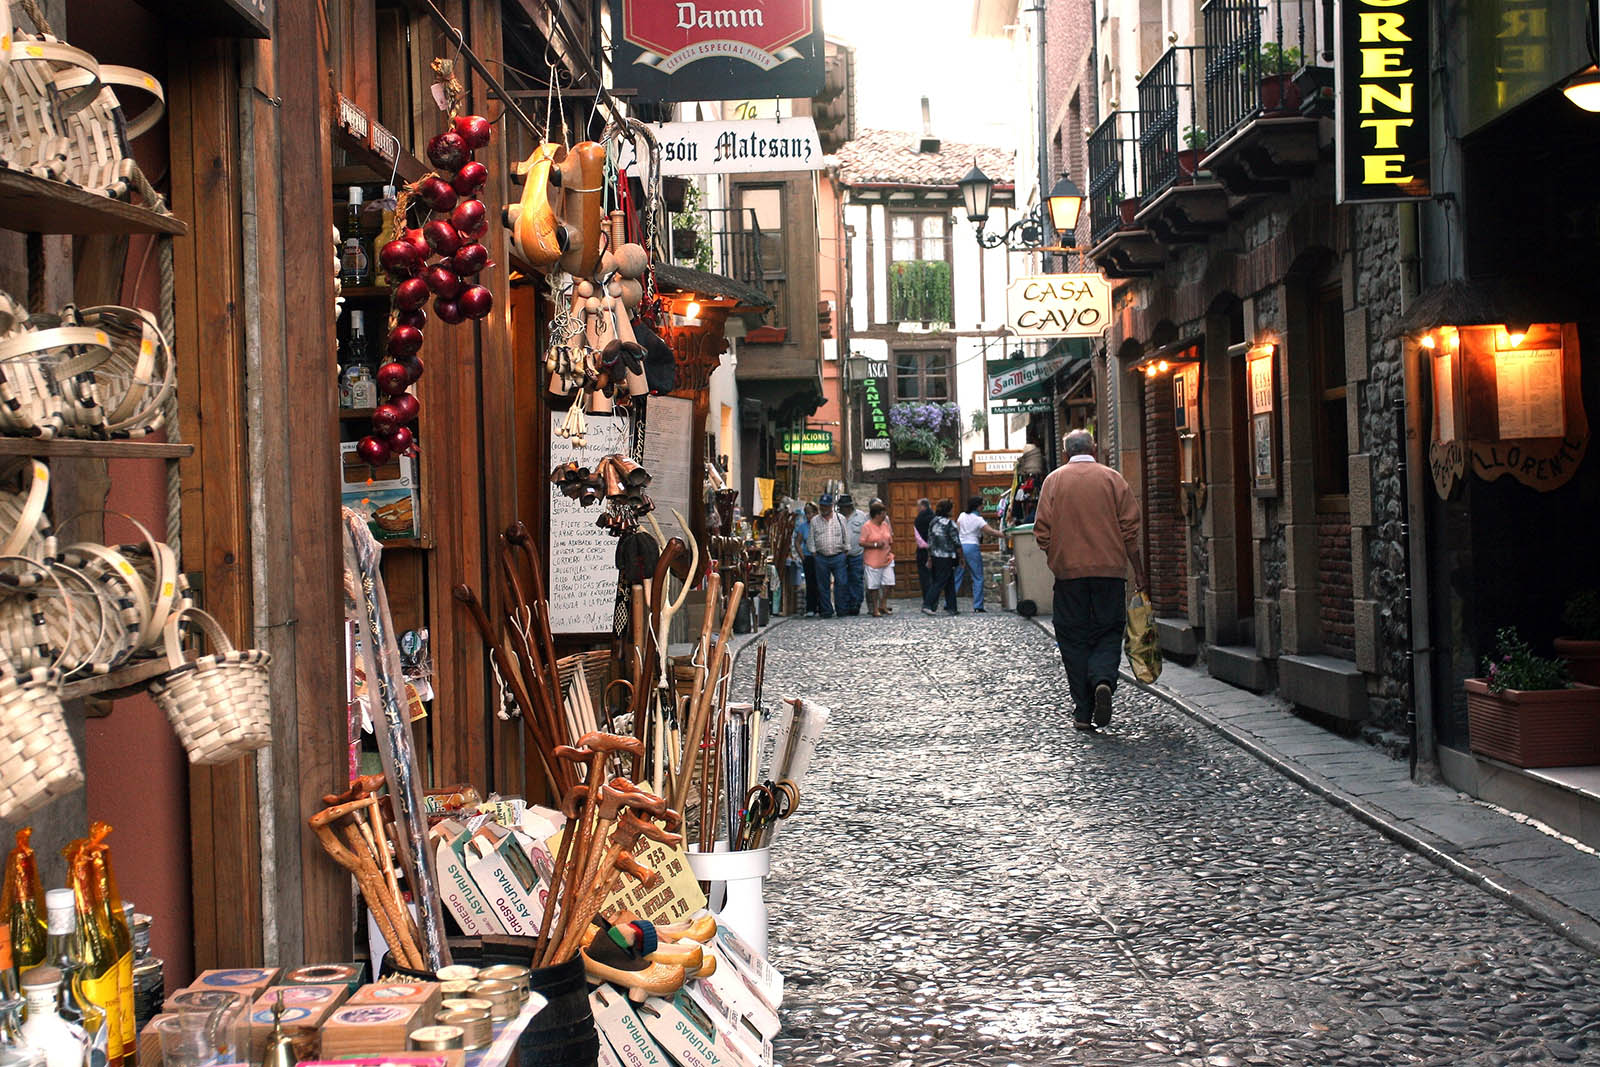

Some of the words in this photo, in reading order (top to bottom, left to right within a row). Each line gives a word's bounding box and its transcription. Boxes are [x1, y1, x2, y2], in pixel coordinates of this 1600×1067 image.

[675, 2, 764, 30] Damm
[666, 48, 697, 70] CERVEZA
[698, 43, 744, 55] ESPECIAL
[746, 49, 771, 66] PILSEN
[1358, 0, 1414, 185] RENTE
[713, 130, 811, 164] Matesanz
[1023, 281, 1094, 302] CASA
[1017, 308, 1100, 332] CAYO
[866, 362, 888, 378] ASCA
[448, 864, 485, 915] ASTURIAS
[493, 868, 532, 918] ASTURIAS
[448, 893, 477, 930] CRESPO
[495, 897, 523, 934] CRESPO
[621, 1014, 659, 1065] ASTURIAS
[675, 1020, 721, 1065] ASTURIAS
